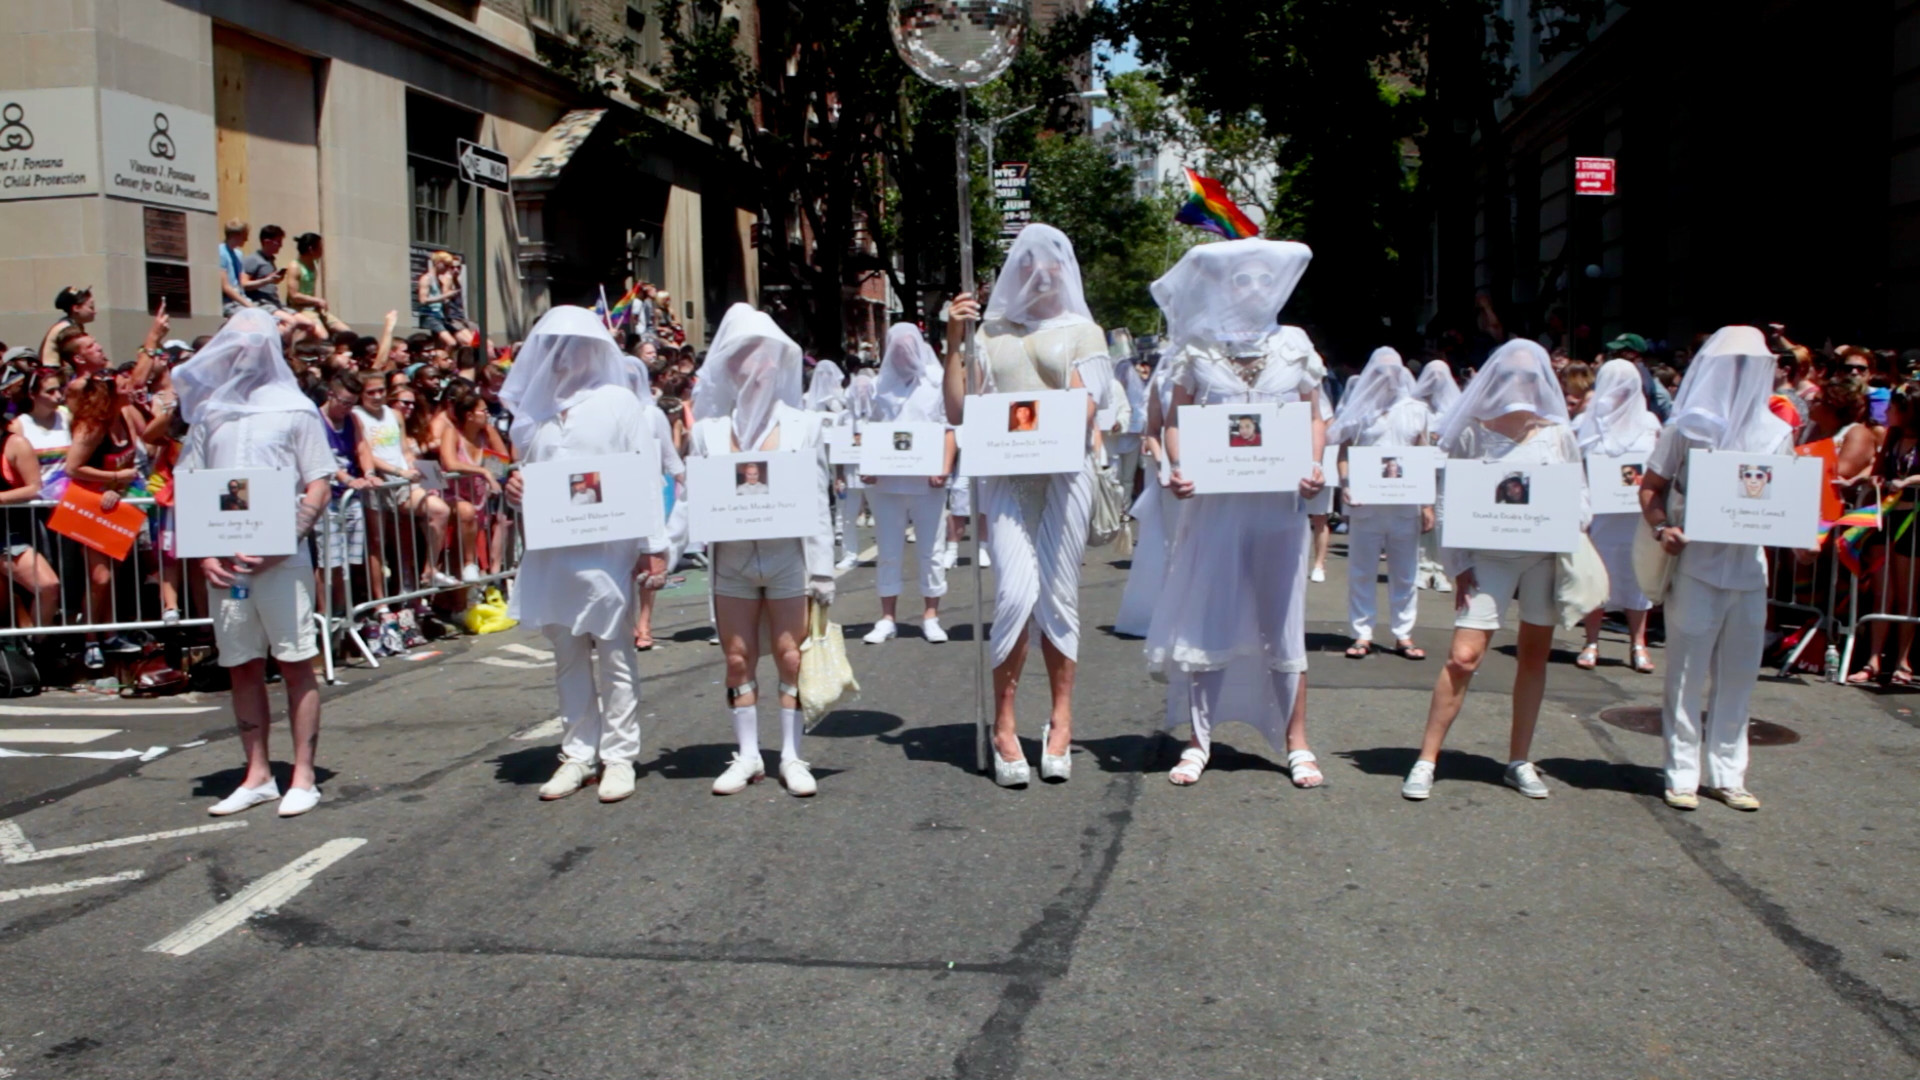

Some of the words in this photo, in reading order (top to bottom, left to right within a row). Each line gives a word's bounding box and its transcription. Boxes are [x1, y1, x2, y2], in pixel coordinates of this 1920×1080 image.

[23, 157, 64, 170] Fontana
[465, 154, 481, 173] ONE
[1582, 161, 1611, 170] STANDING
[129, 159, 158, 176] Vincent
[168, 167, 196, 183] Fontana
[994, 168, 1017, 178] NYC
[1575, 171, 1606, 180] ANYTIME
[3, 174, 31, 188] Child
[33, 173, 86, 187] Protection
[114, 173, 140, 189] Center
[140, 178, 152, 192] for
[153, 180, 174, 195] Child
[175, 184, 210, 200] Protection
[994, 178, 1026, 187] PRIDE
[1003, 200, 1031, 210] JUNE
[62, 500, 76, 511] WE
[77, 507, 95, 520] ARE
[95, 515, 136, 539] ORLANDO
